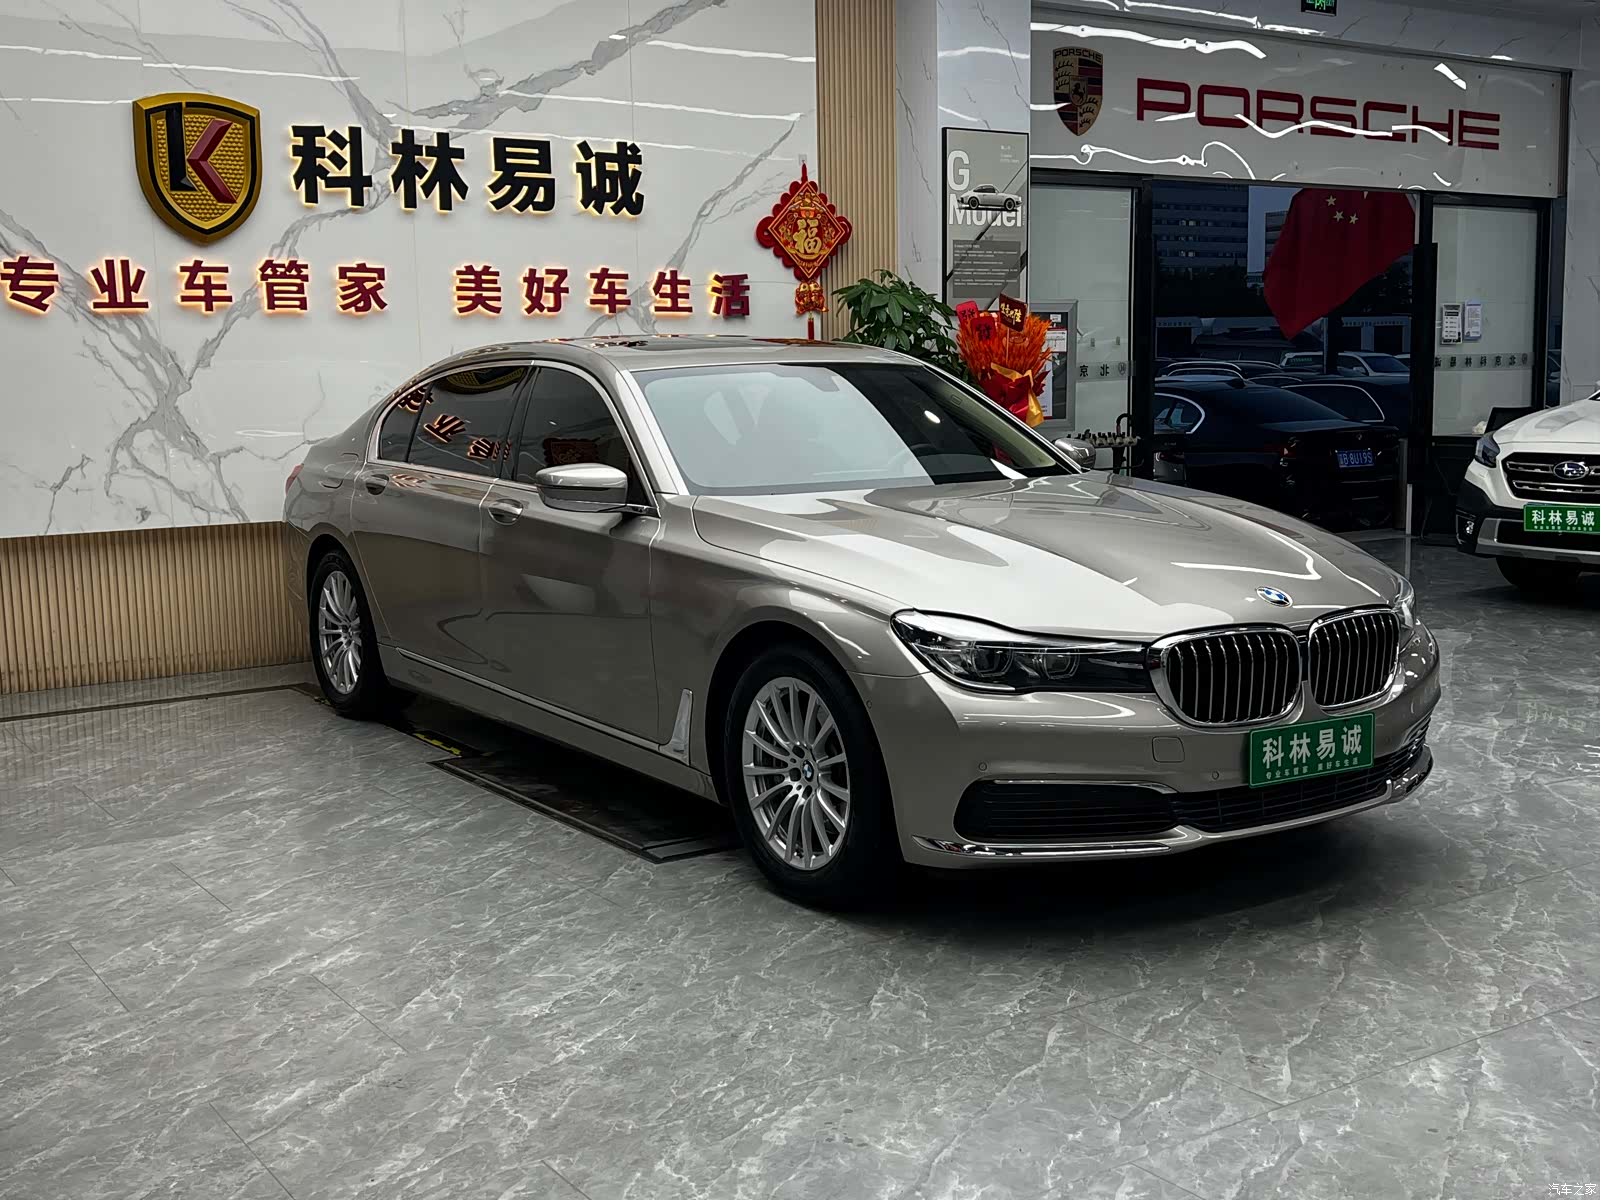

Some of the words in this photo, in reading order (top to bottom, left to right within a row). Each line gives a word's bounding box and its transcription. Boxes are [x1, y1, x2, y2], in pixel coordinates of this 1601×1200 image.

[1054, 48, 1101, 63] PORSCHE
[1137, 78, 1500, 150] PORSCHE
[290, 124, 646, 216] 科林易诚
[947, 150, 970, 191] G
[793, 219, 822, 254] 福
[1, 256, 389, 314] 专业车管家
[455, 264, 751, 317] 美好车生活
[1532, 509, 1595, 526] 科林易诚
[1262, 724, 1362, 769] 科林易诚
